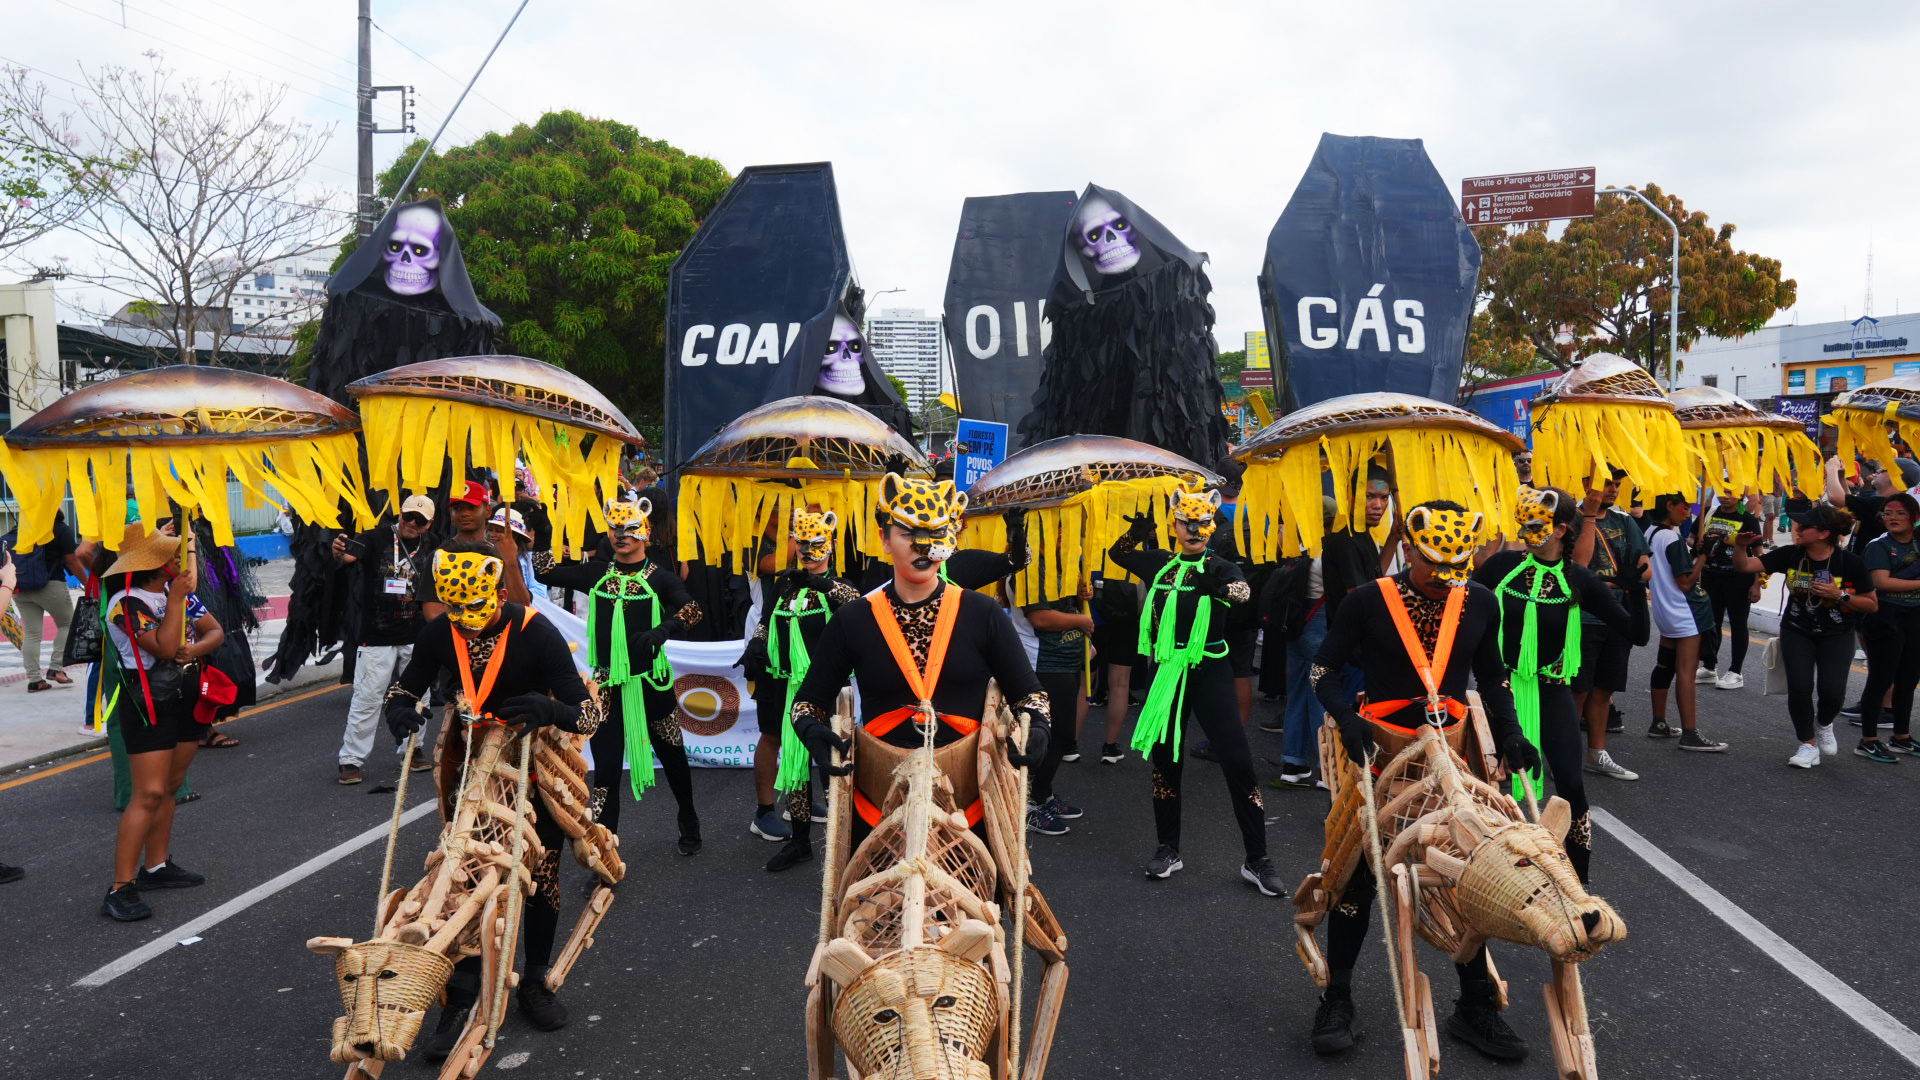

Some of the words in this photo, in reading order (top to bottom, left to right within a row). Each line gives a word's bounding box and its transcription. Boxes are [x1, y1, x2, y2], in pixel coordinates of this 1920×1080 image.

[1473, 179, 1494, 188] Visite
[1504, 176, 1532, 186] Parque
[1535, 174, 1545, 182] do
[1547, 171, 1577, 182] Utinga!
[1493, 194, 1527, 202] Terminal
[1529, 189, 1572, 199] Rodoviário
[1492, 205, 1533, 215] Aeroporto
[1297, 283, 1426, 354] GÁS
[1823, 342, 1853, 353] Instituto
[1865, 336, 1908, 349] Construção
[968, 429, 995, 441] FLORESTA
[968, 440, 982, 454] EM
[966, 456, 993, 471] POVOS
[684, 745, 742, 754] NADORA
